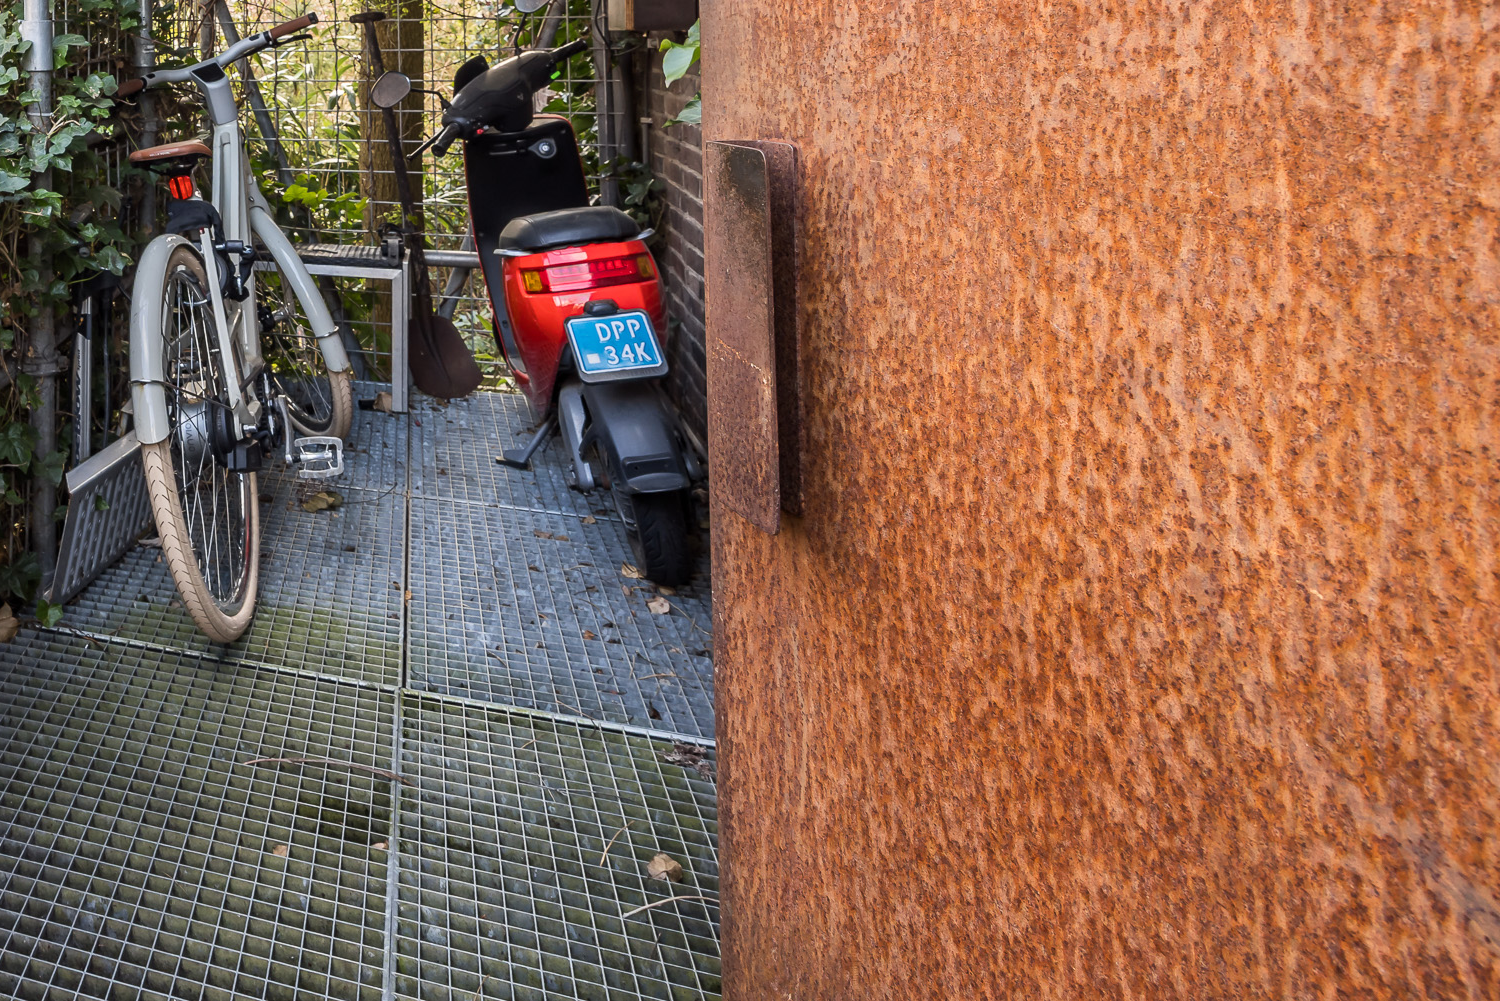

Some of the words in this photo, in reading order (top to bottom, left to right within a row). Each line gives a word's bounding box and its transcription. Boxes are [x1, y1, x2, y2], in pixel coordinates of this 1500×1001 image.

[595, 319, 640, 342] DPP
[604, 342, 652, 365] 34K
[184, 415, 196, 452] envio
